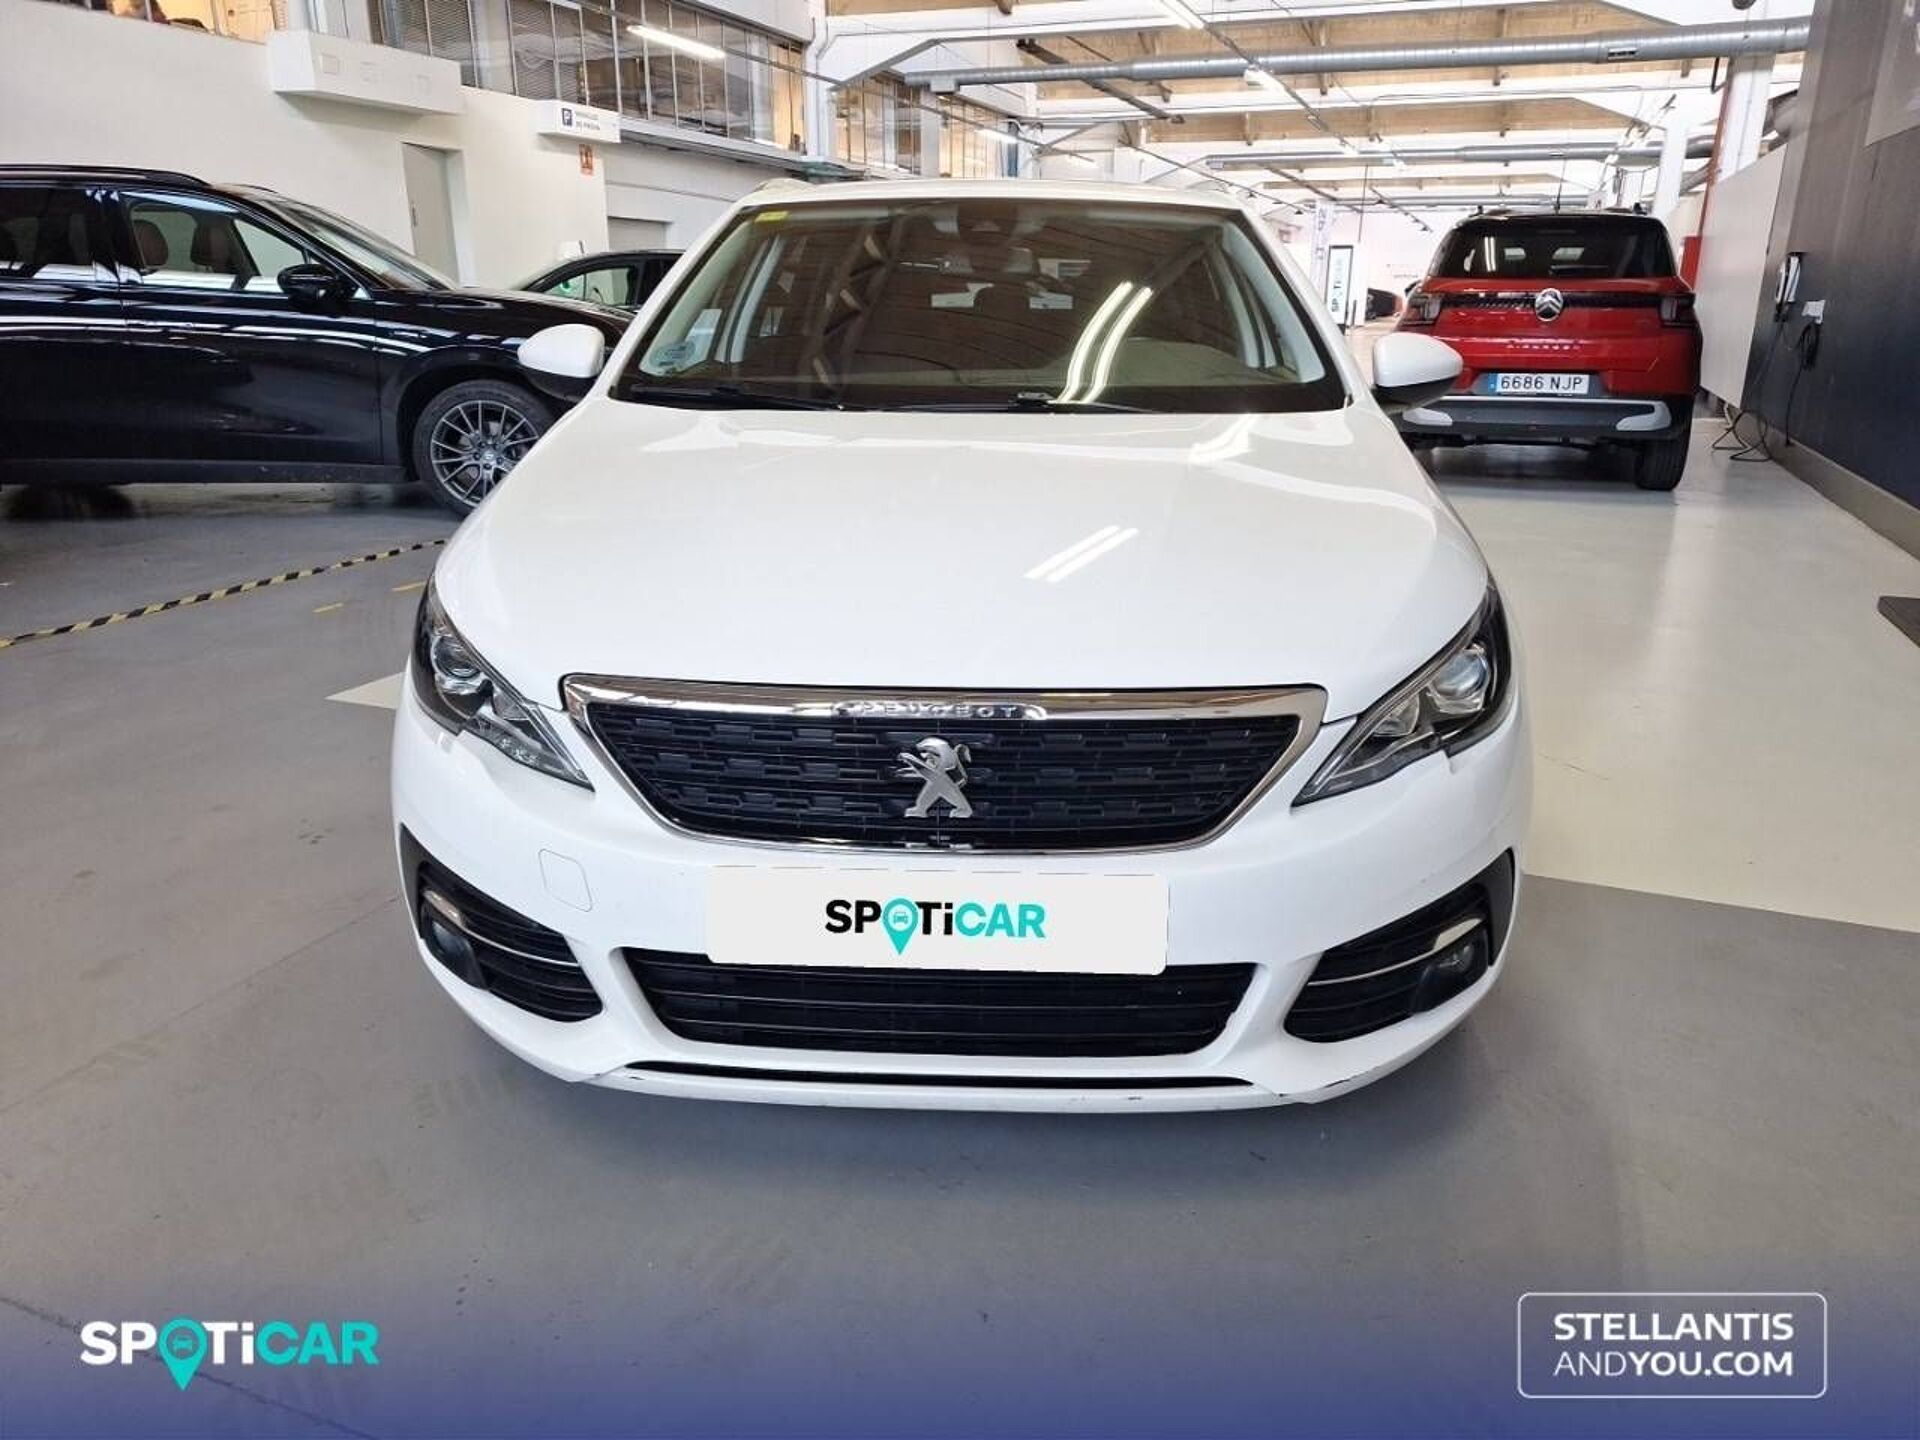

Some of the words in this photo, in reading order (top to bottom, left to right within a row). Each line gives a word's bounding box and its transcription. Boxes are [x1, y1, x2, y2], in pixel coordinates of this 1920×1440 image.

[1501, 375, 1544, 390] 6686
[1550, 376, 1583, 391] NJP
[863, 701, 1018, 718] PEUGEOT
